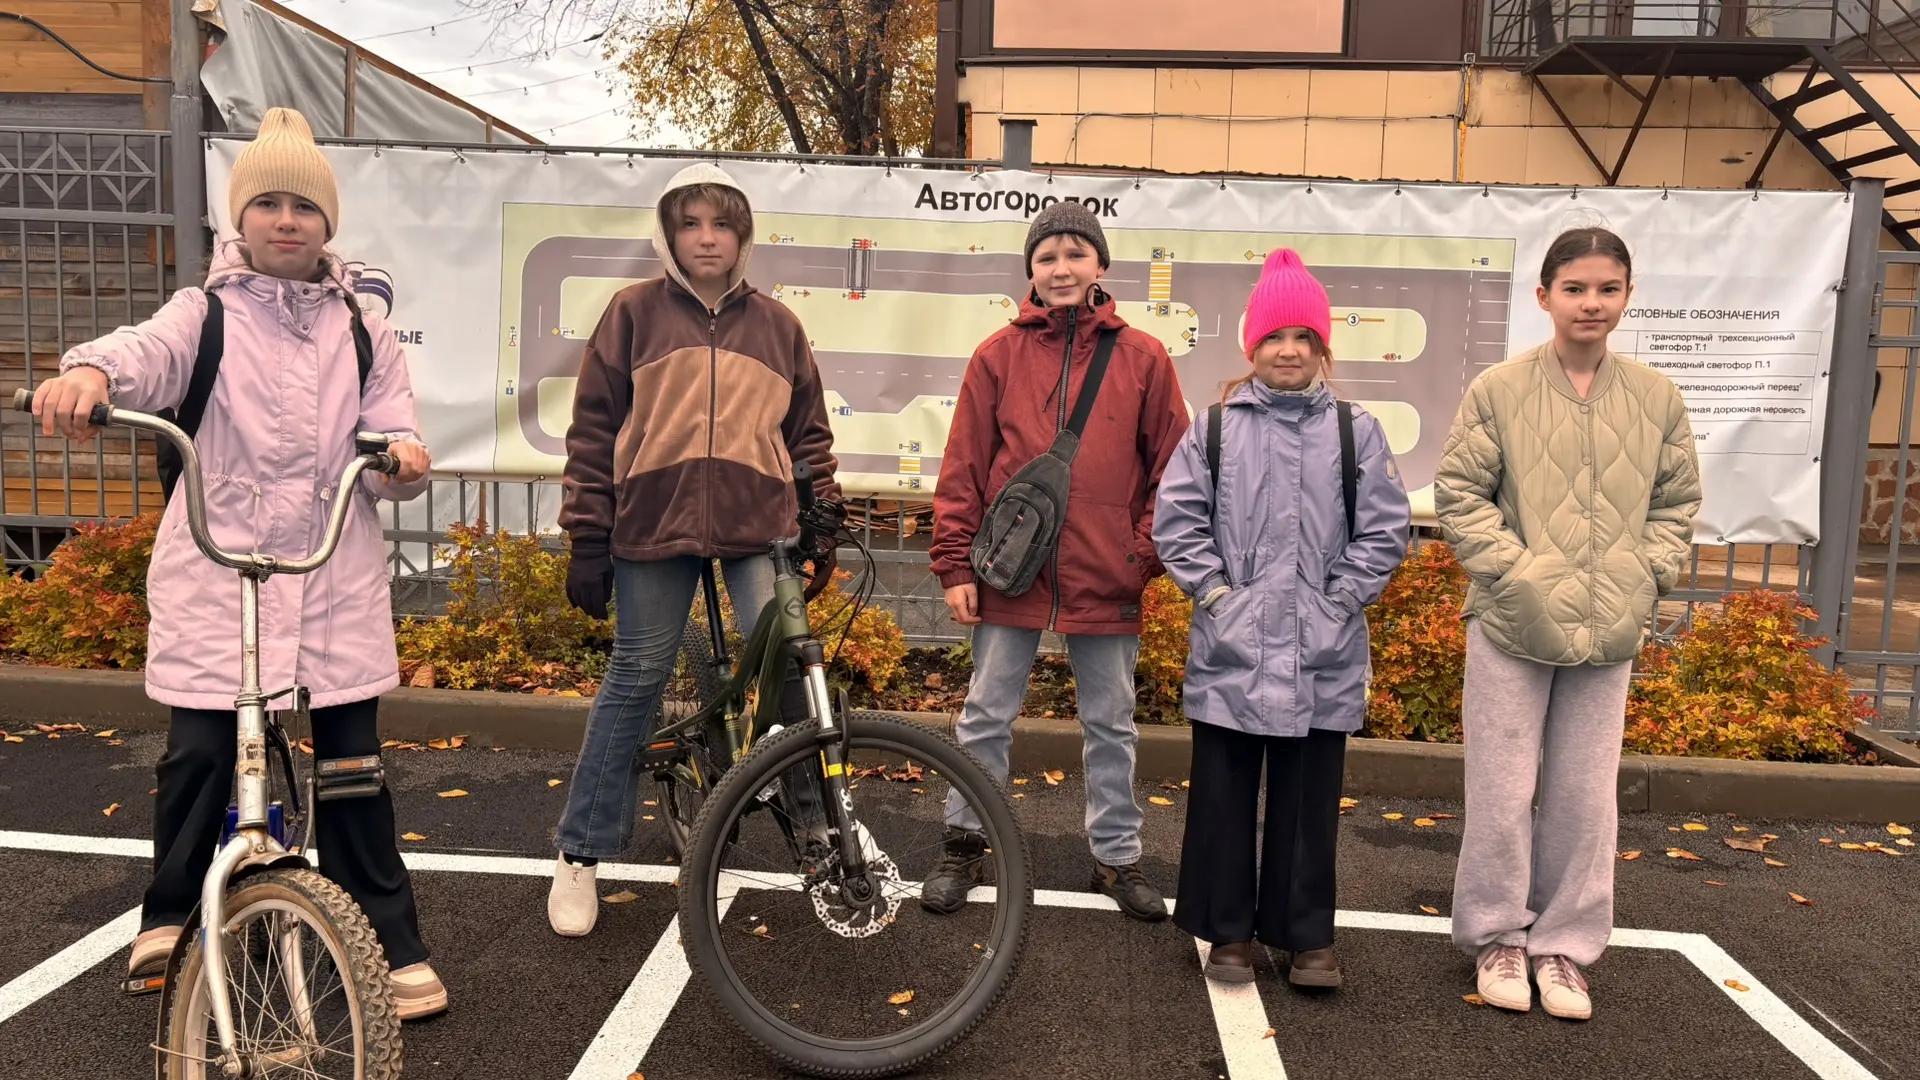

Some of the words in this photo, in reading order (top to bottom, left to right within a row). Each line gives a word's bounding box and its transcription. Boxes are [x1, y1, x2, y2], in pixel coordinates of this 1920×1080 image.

[914, 183, 1119, 218] Автогороок
[1622, 308, 1687, 319] УСЛОВНЫЕ
[1690, 309, 1780, 320] ОБОЗНАЧЕНИЯ
[394, 330, 423, 345] ЫЕ
[1651, 333, 1713, 342] транспортный
[1718, 333, 1795, 342] трехсекционный
[1649, 344, 1692, 352] светофор
[1648, 361, 1705, 369] пешеходный
[1707, 361, 1752, 370] светофор
[1713, 406, 1761, 415] дорожная
[1763, 406, 1806, 414] неровность
